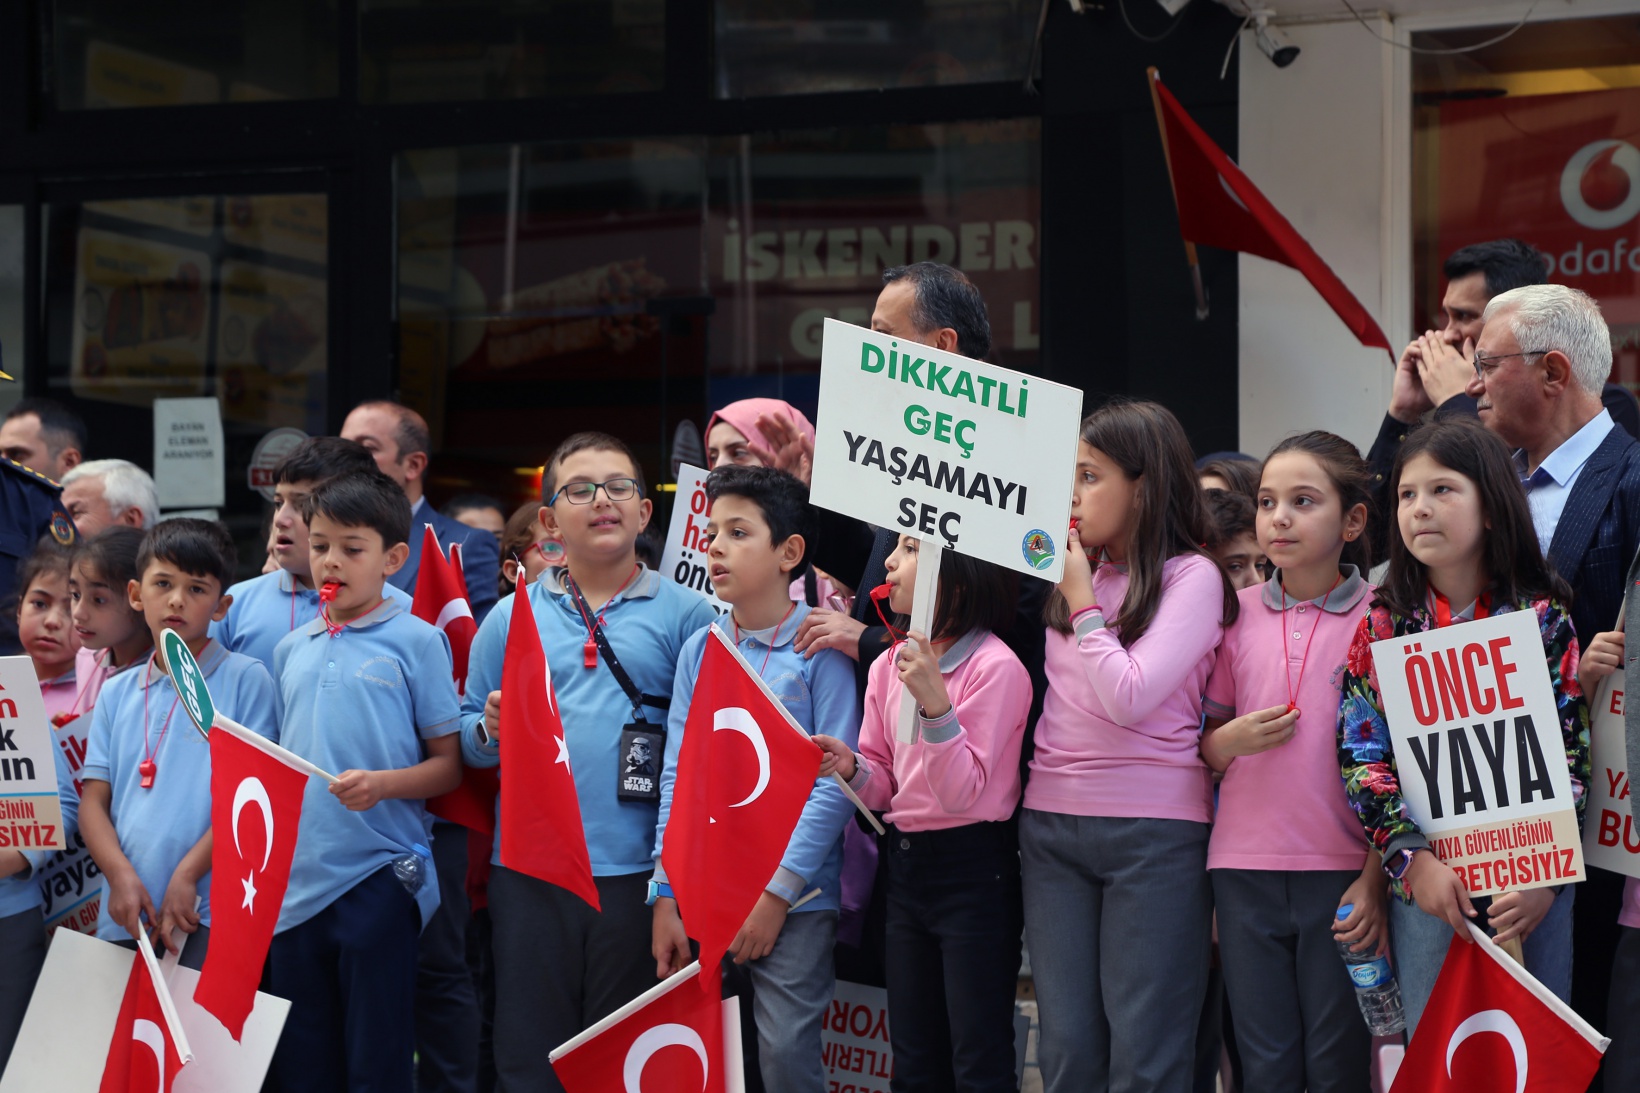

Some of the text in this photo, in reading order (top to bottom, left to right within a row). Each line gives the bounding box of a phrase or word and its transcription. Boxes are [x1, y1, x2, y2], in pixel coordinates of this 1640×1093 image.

[723, 218, 1035, 283] İSKENDER
[860, 341, 1029, 419] DİKKATLİ
[163, 450, 214, 460] ARANIYOR
[168, 436, 209, 447] ELEMAN
[903, 404, 977, 459] GEÇ
[842, 430, 1028, 516] YAŞAMAYI
[896, 497, 962, 550] SEÇ
[177, 643, 203, 723] GEÇ
[1403, 635, 1526, 727] ÖNCE
[624, 776, 652, 785] STAR
[624, 783, 653, 793] WARS
[1407, 714, 1556, 820] YAYA
[1429, 818, 1554, 861] YAYA GÜVENLİĞİNİN
[1453, 844, 1577, 892] BETÇİSİYİZ
[821, 1041, 895, 1080] TLERİN
